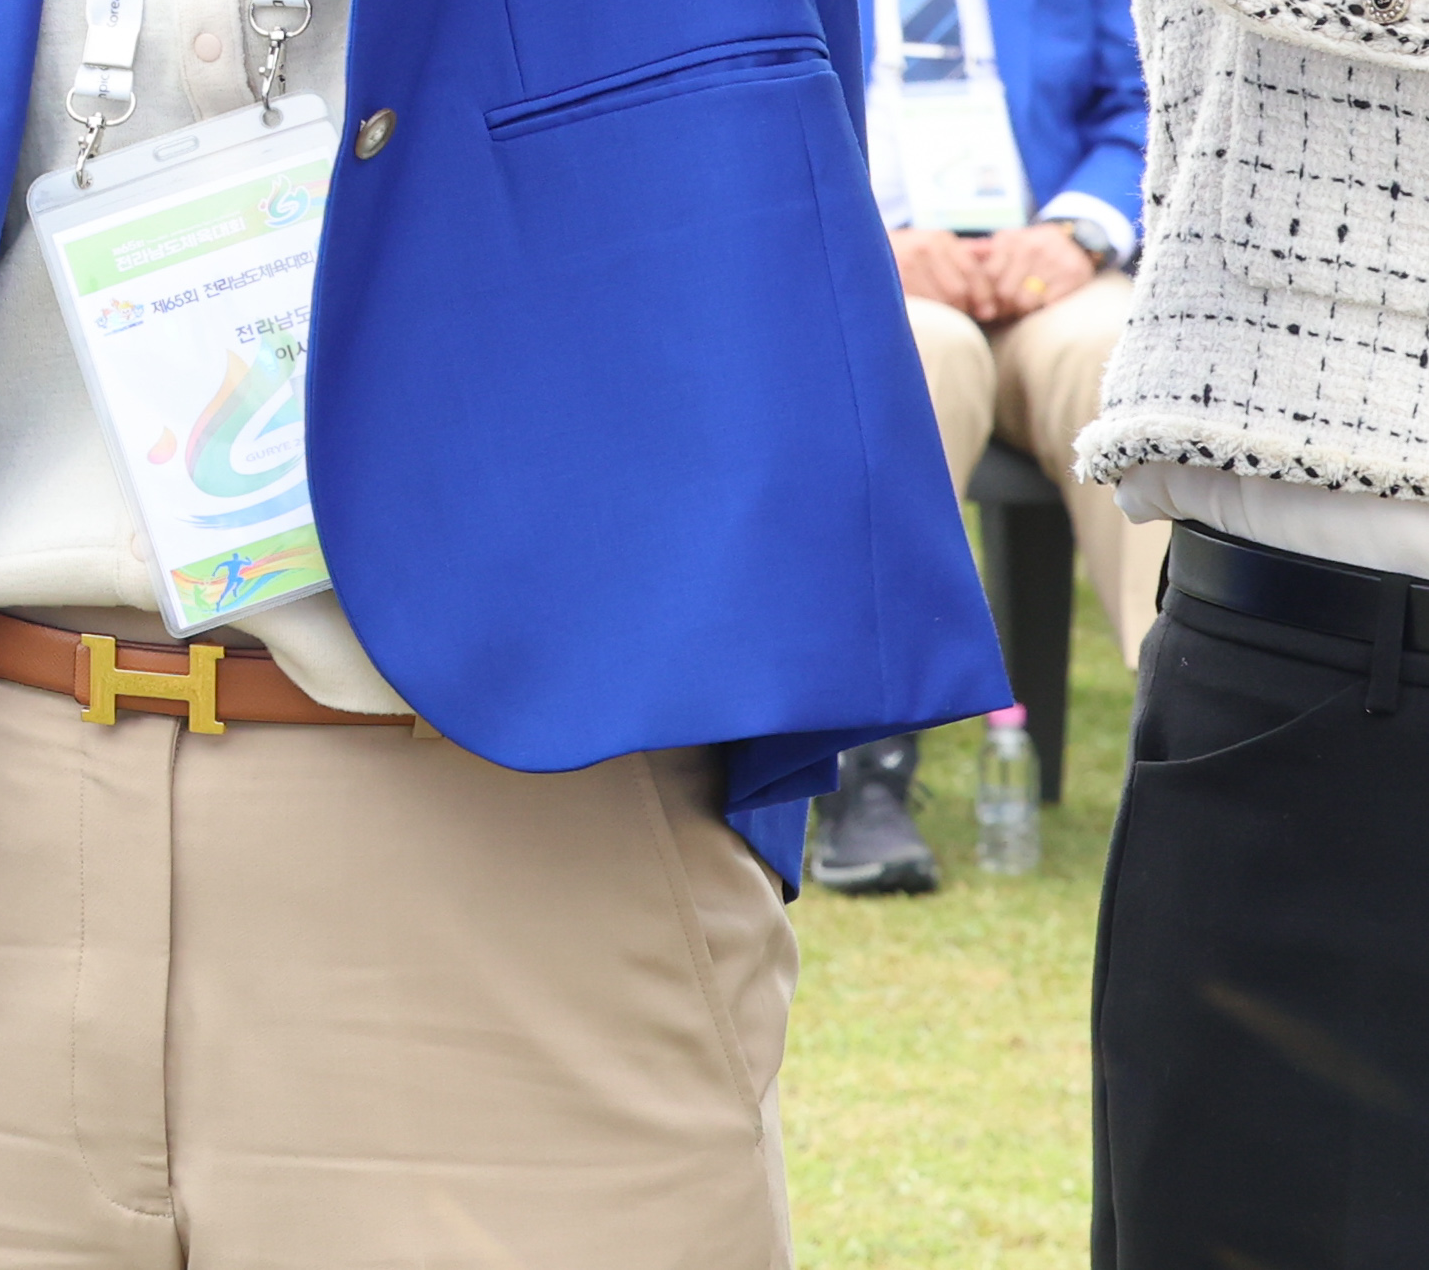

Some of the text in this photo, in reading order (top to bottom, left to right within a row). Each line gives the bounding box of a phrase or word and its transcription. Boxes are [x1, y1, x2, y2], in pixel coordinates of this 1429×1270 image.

[114, 216, 248, 274] 전라남도체육대회
[150, 250, 316, 315] 제65회 전라남도체육대회
